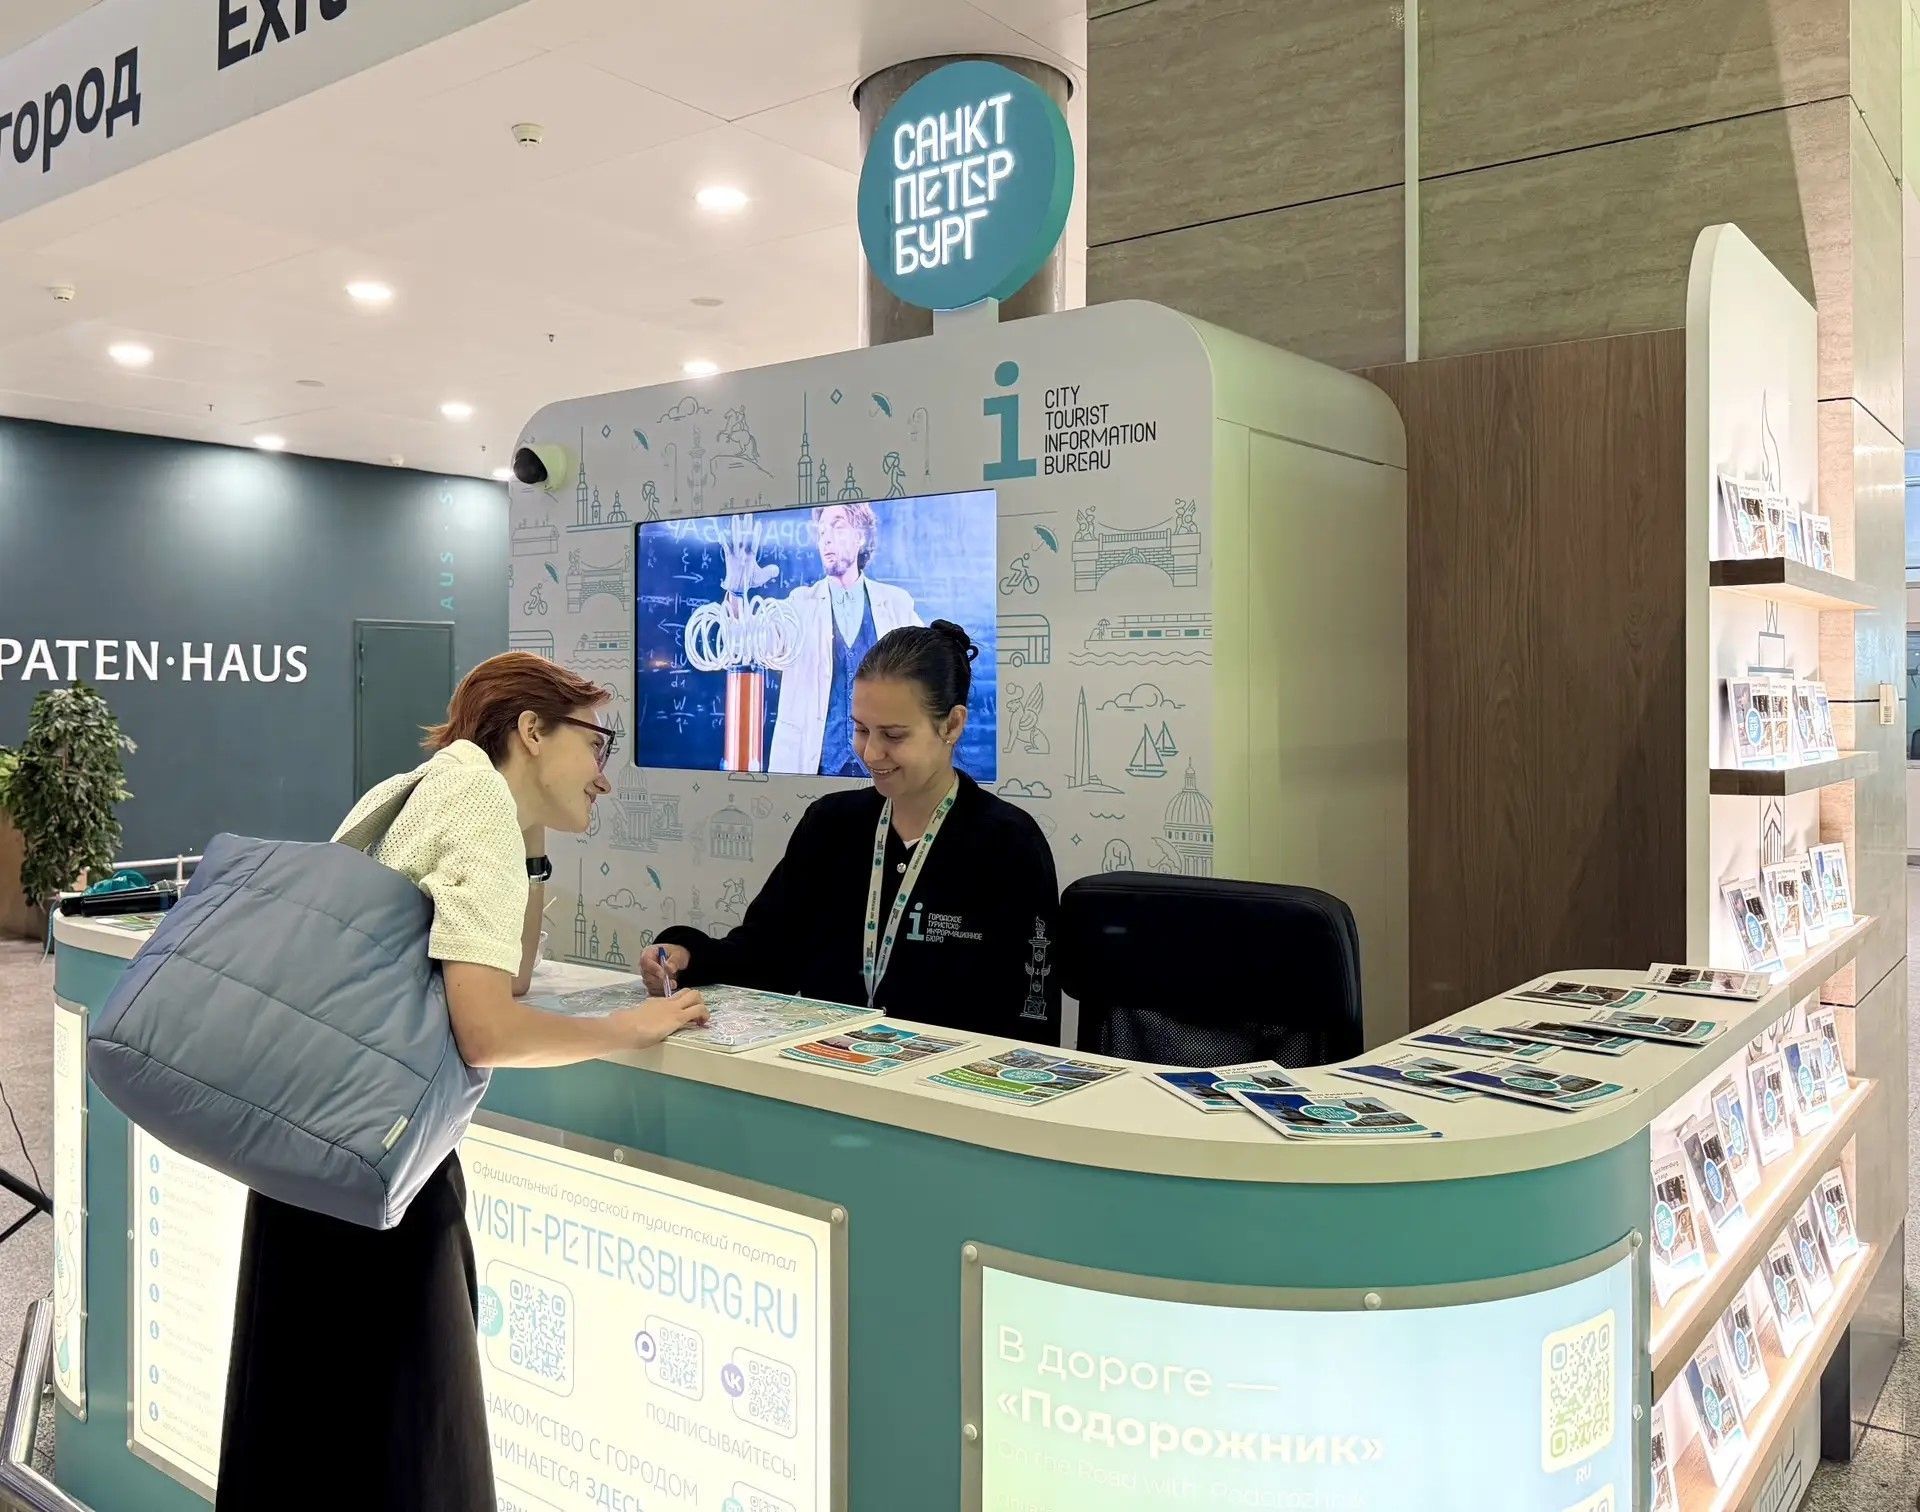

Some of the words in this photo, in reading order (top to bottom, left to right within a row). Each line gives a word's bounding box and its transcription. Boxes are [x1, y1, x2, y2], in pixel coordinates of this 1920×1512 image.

[0, 46, 141, 173] ород
[894, 93, 1012, 170] САНКТ
[894, 150, 1015, 223] ПЕТЕР
[896, 210, 988, 275] БУРГ
[1045, 386, 1080, 408] CITY
[1045, 404, 1109, 431] TOURIST
[1045, 421, 1156, 453] INFORMATION
[1045, 450, 1111, 475] BUREAU
[472, 1160, 558, 1198] Официальный
[561, 1188, 629, 1221] городской
[632, 1210, 728, 1250] туристский
[732, 1241, 798, 1273] портал
[472, 1189, 798, 1340] VISIT-PETERSBURG.RU
[999, 1324, 1024, 1363] В
[1037, 1342, 1214, 1397] дороге
[646, 1401, 796, 1481] ПОДПИСЫВАЙТЕСЬ!
[996, 1385, 1385, 1467] «Подорожник»
[589, 1438, 601, 1461] С
[606, 1444, 699, 1506] ГОРОДОМ
[1576, 1463, 1592, 1484] RU
